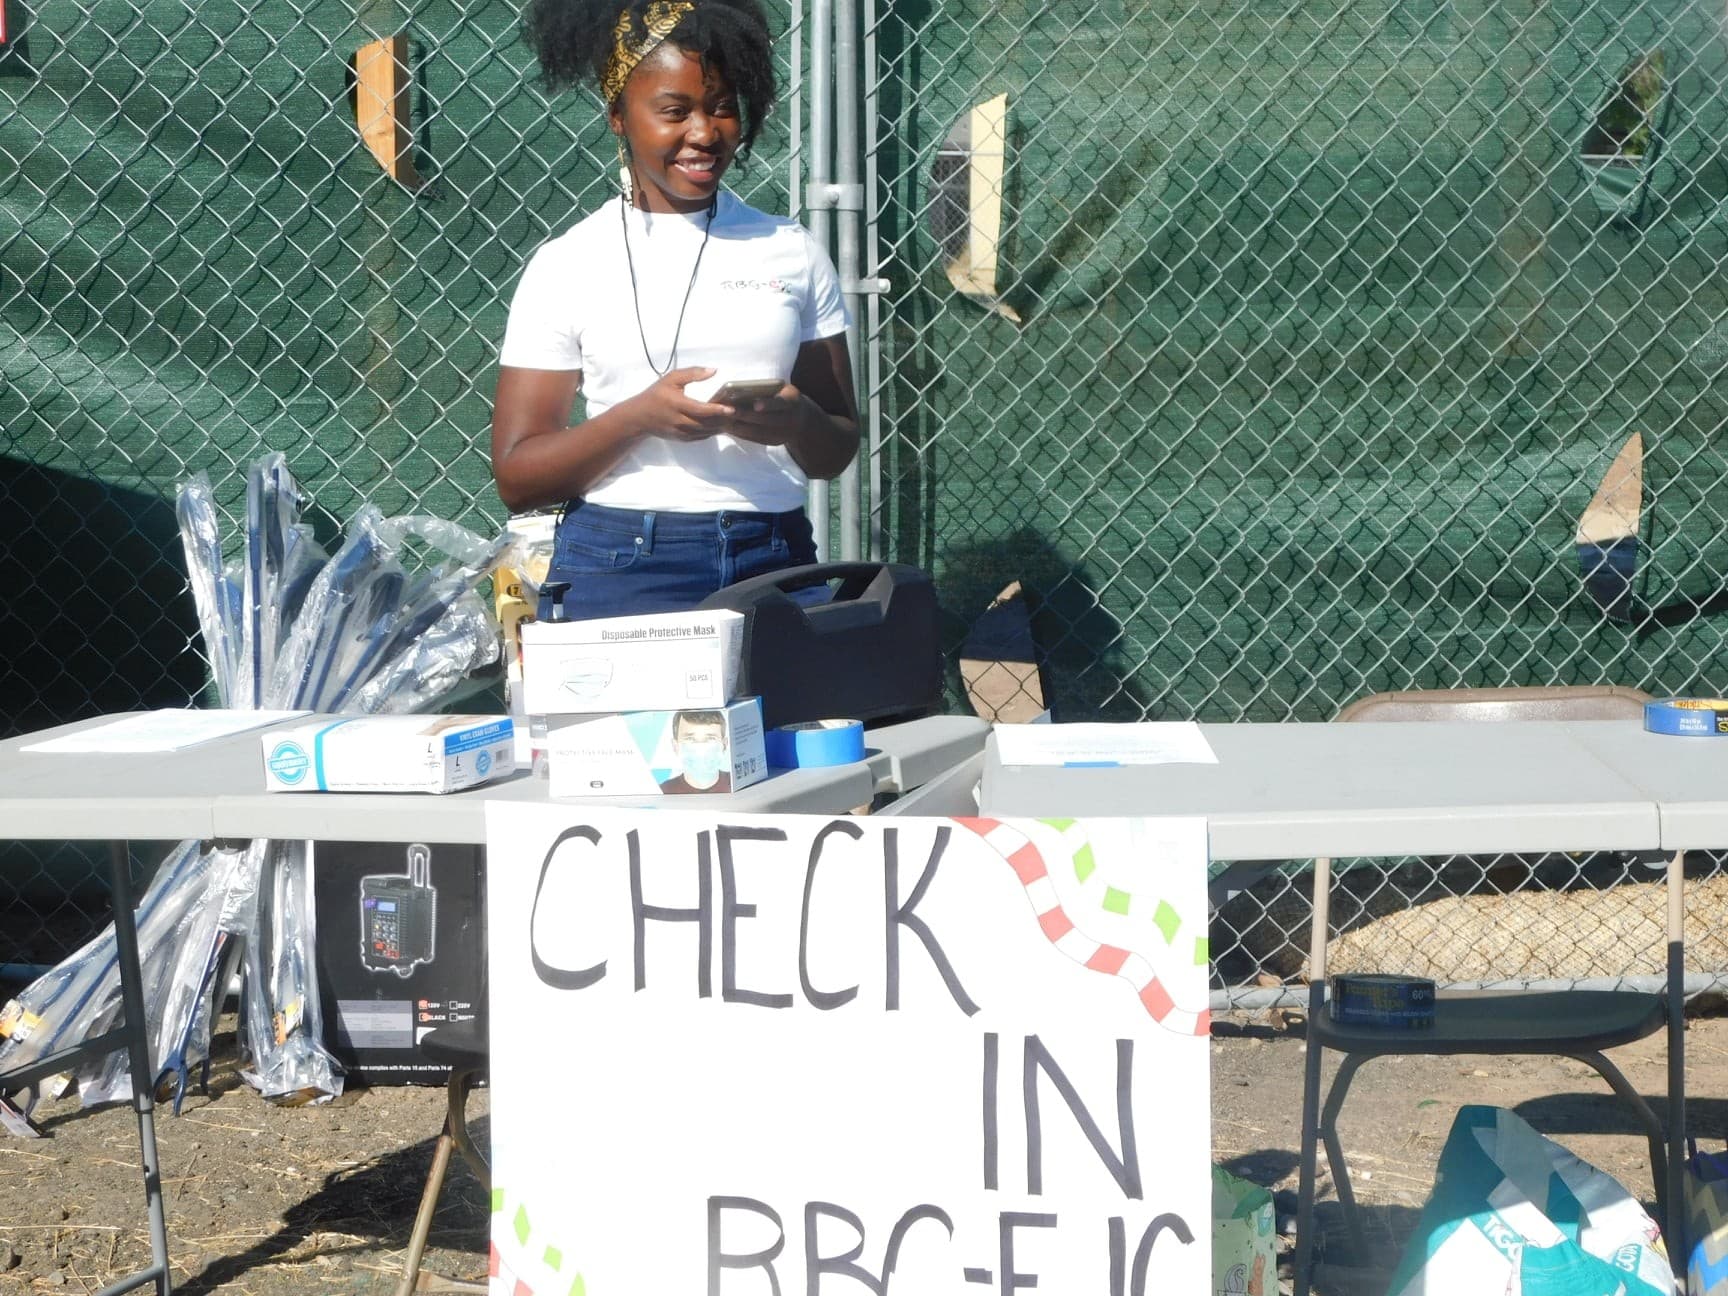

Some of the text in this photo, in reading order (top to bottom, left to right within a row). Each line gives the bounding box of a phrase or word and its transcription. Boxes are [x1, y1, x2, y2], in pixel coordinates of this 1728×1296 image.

[601, 624, 716, 641] Disposable Protective Mask
[427, 742, 433, 753] L
[455, 755, 461, 767] L
[529, 820, 981, 1017] CHECK
[983, 1031, 1144, 1201] IN
